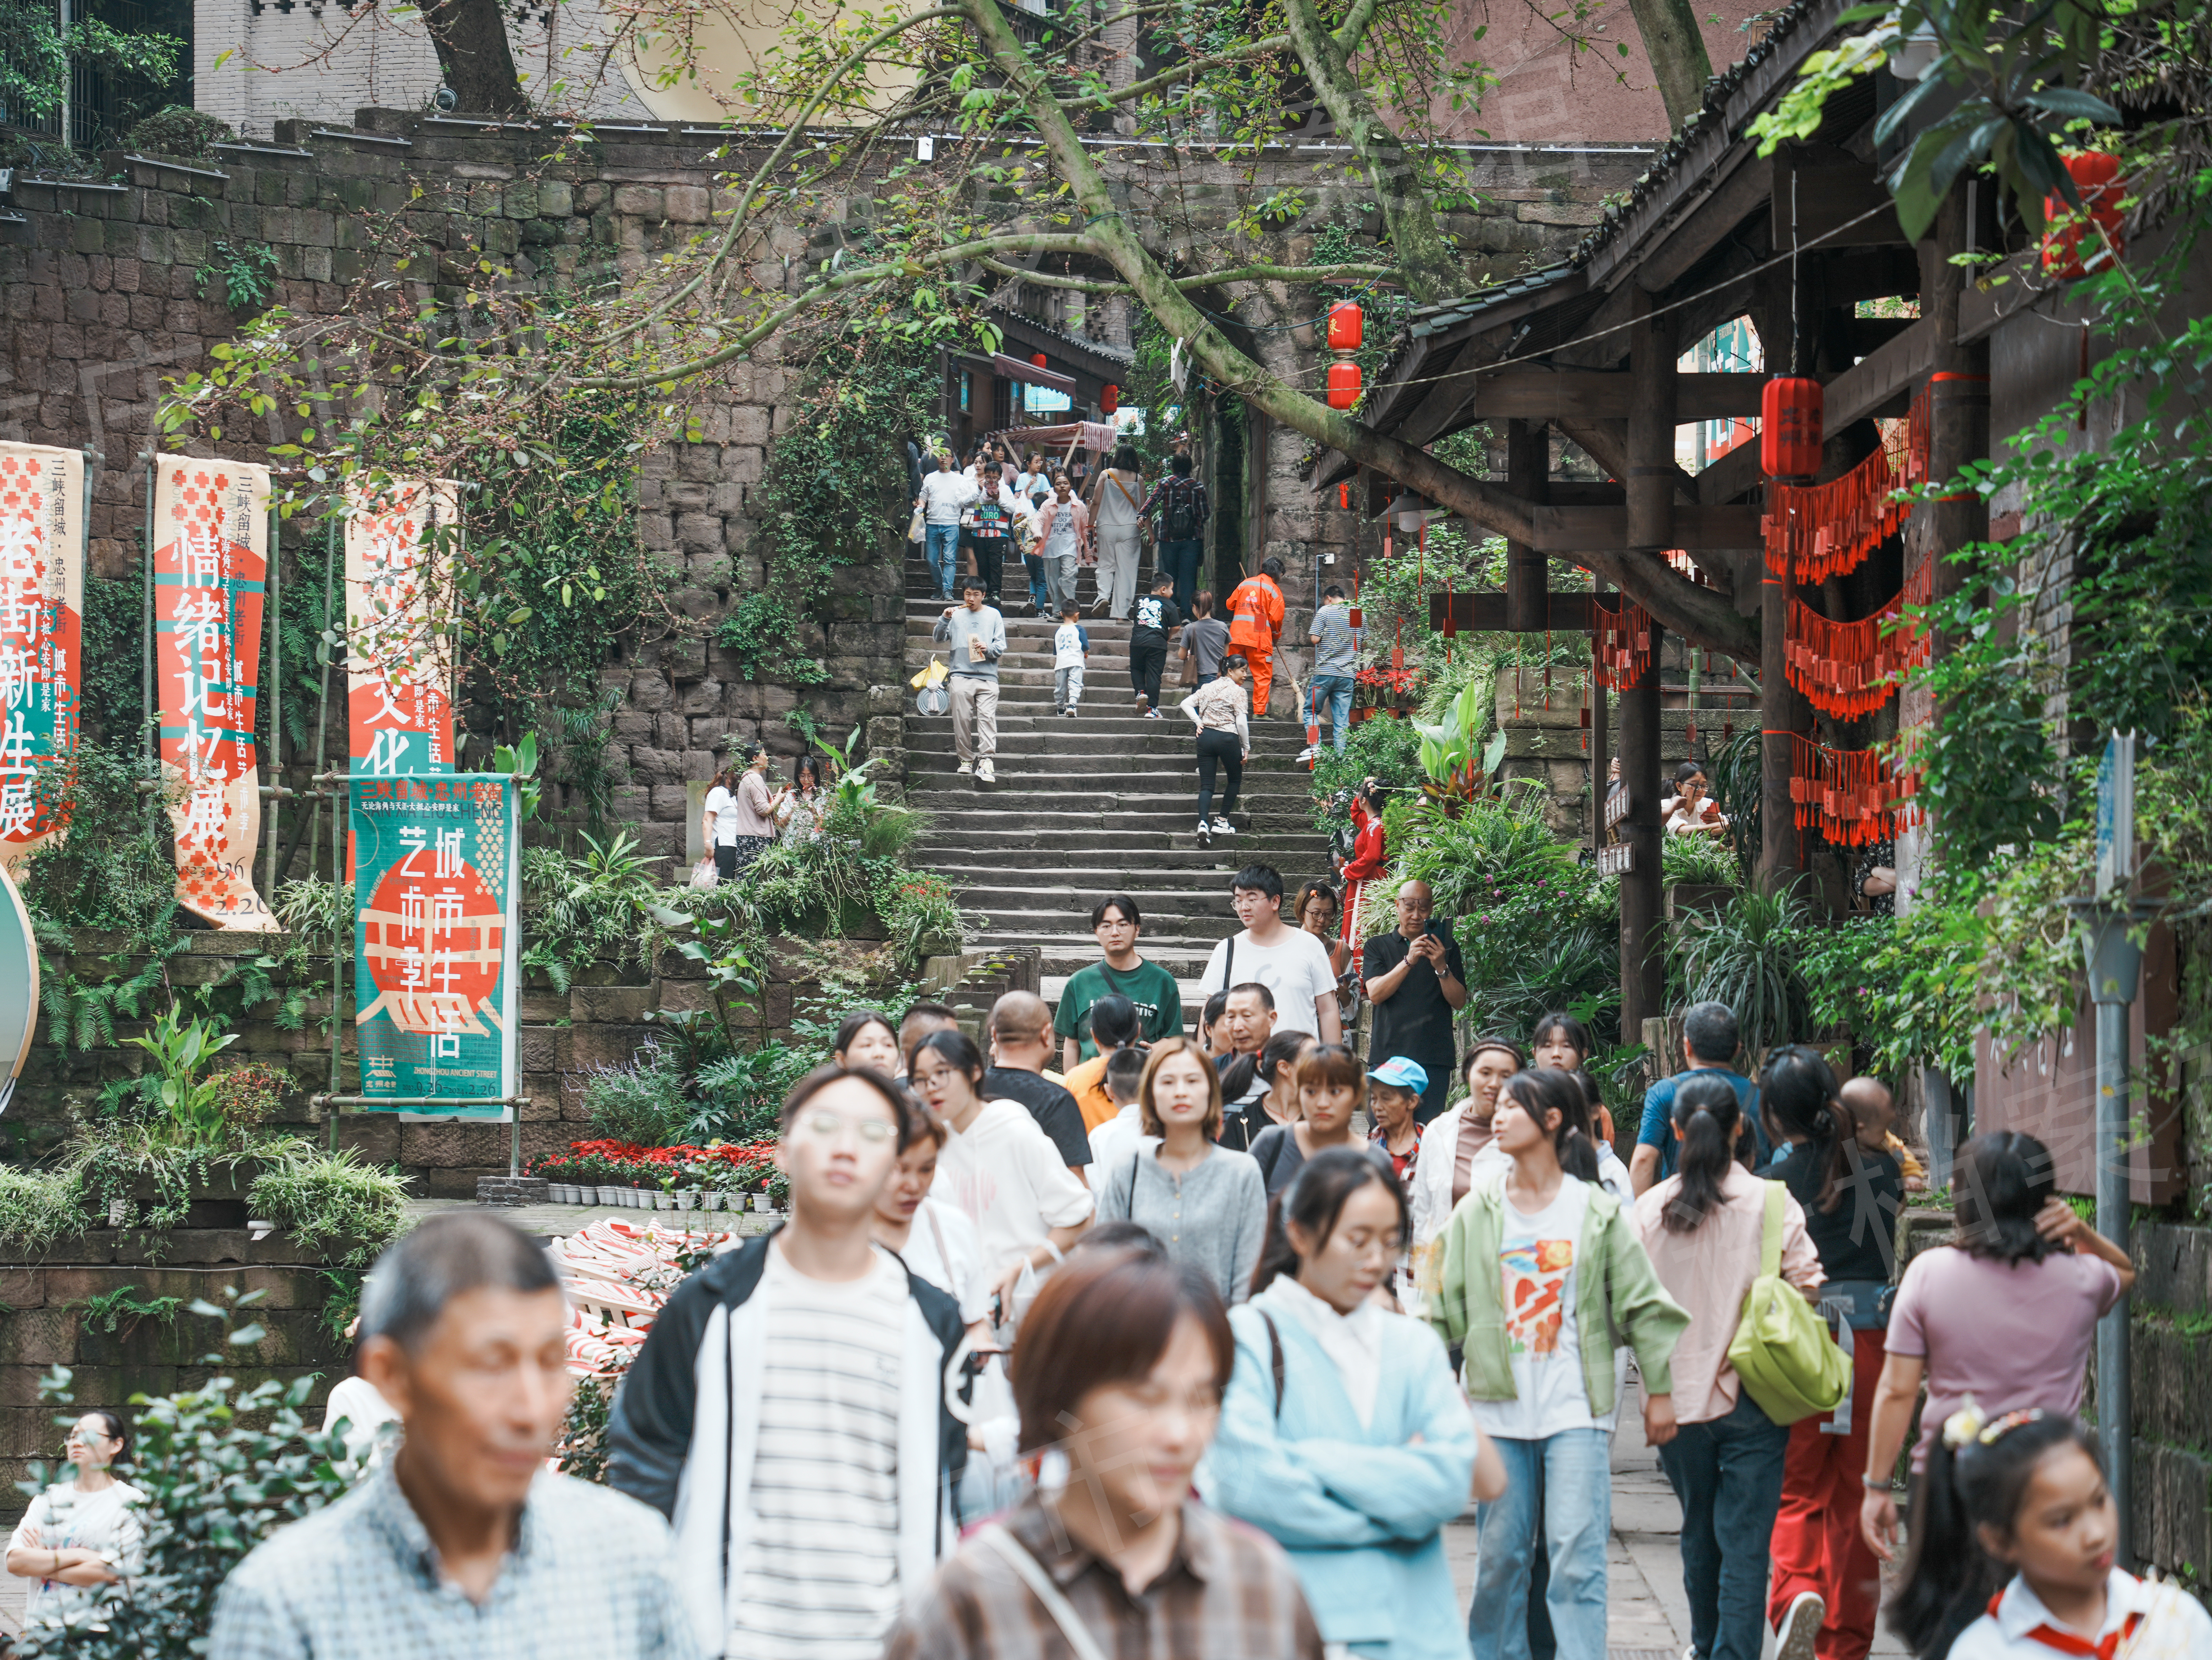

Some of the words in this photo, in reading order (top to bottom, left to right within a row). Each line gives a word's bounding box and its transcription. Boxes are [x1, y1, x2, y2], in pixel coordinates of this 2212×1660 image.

[51, 460, 67, 635] 三峡留城·忠州老街
[232, 476, 253, 647] 三峡留城·忠州老街
[980, 511, 1000, 520] EURO
[38, 494, 52, 712] 无论海角与天涯·大抵心安即是家
[170, 528, 228, 844] 情绪记忆展
[233, 659, 249, 841] 城市生活艺术季
[360, 779, 503, 802] 三峡留城·忠州老街
[361, 801, 460, 812] 无论海角与天涯·大抵心安即是家
[395, 826, 427, 1012] 艺术季
[430, 827, 465, 1058] 城市生活
[469, 919, 477, 960] 非遗文化展
[414, 1067, 450, 1076] ZHONGZHOU
[450, 1068, 476, 1077] ANCIENT
[476, 1070, 498, 1078] STREET
